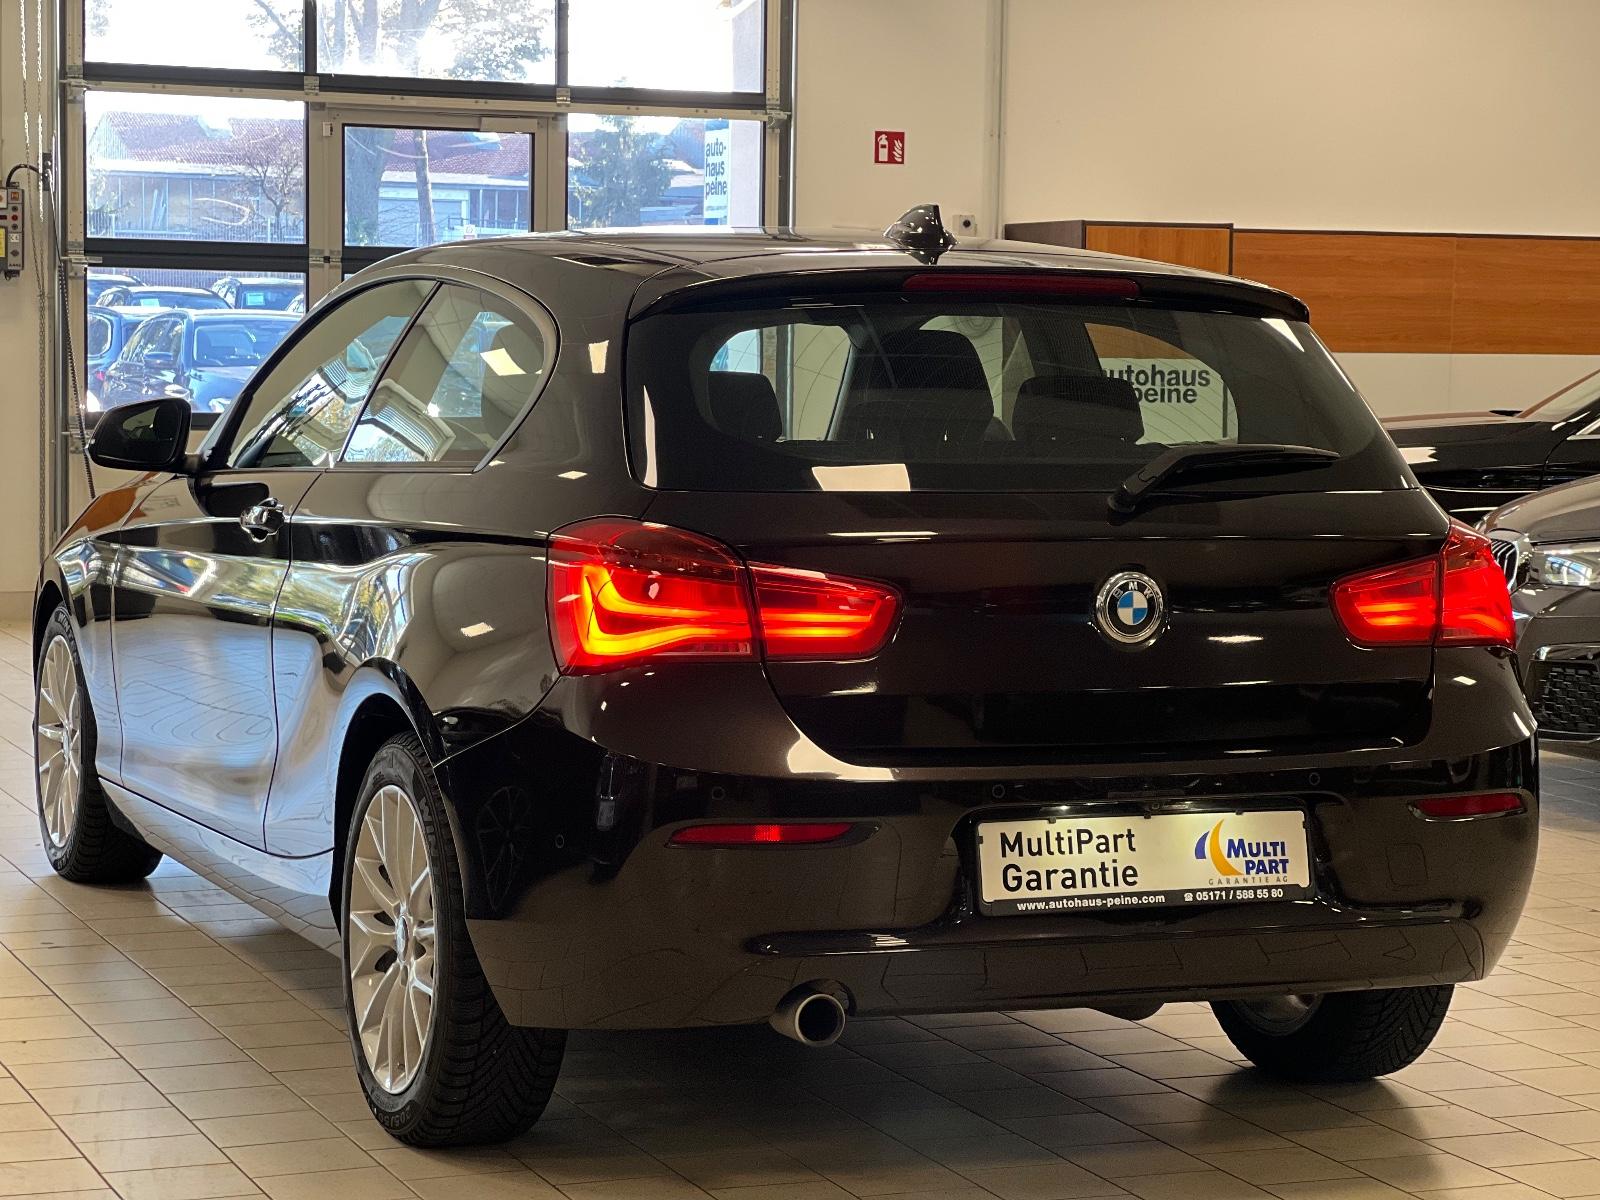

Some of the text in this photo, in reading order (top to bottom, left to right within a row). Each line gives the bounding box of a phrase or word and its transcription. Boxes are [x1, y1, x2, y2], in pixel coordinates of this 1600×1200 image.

[705, 138, 726, 157] auto-
[705, 158, 725, 177] haus
[705, 177, 727, 200] peine
[1112, 581, 1154, 599] BMW
[1000, 828, 1137, 858] MultiPart
[1226, 838, 1286, 858] MULTI
[1002, 859, 1139, 892] Garantie
[1244, 858, 1289, 875] PART
[1208, 875, 1288, 885] GARANTIE AG
[1016, 894, 1166, 911] www.autohaus-peine.com
[1196, 890, 1226, 901] 05171
[1236, 889, 1255, 899] 588
[1257, 889, 1269, 898] 55
[1271, 888, 1284, 898] 80
